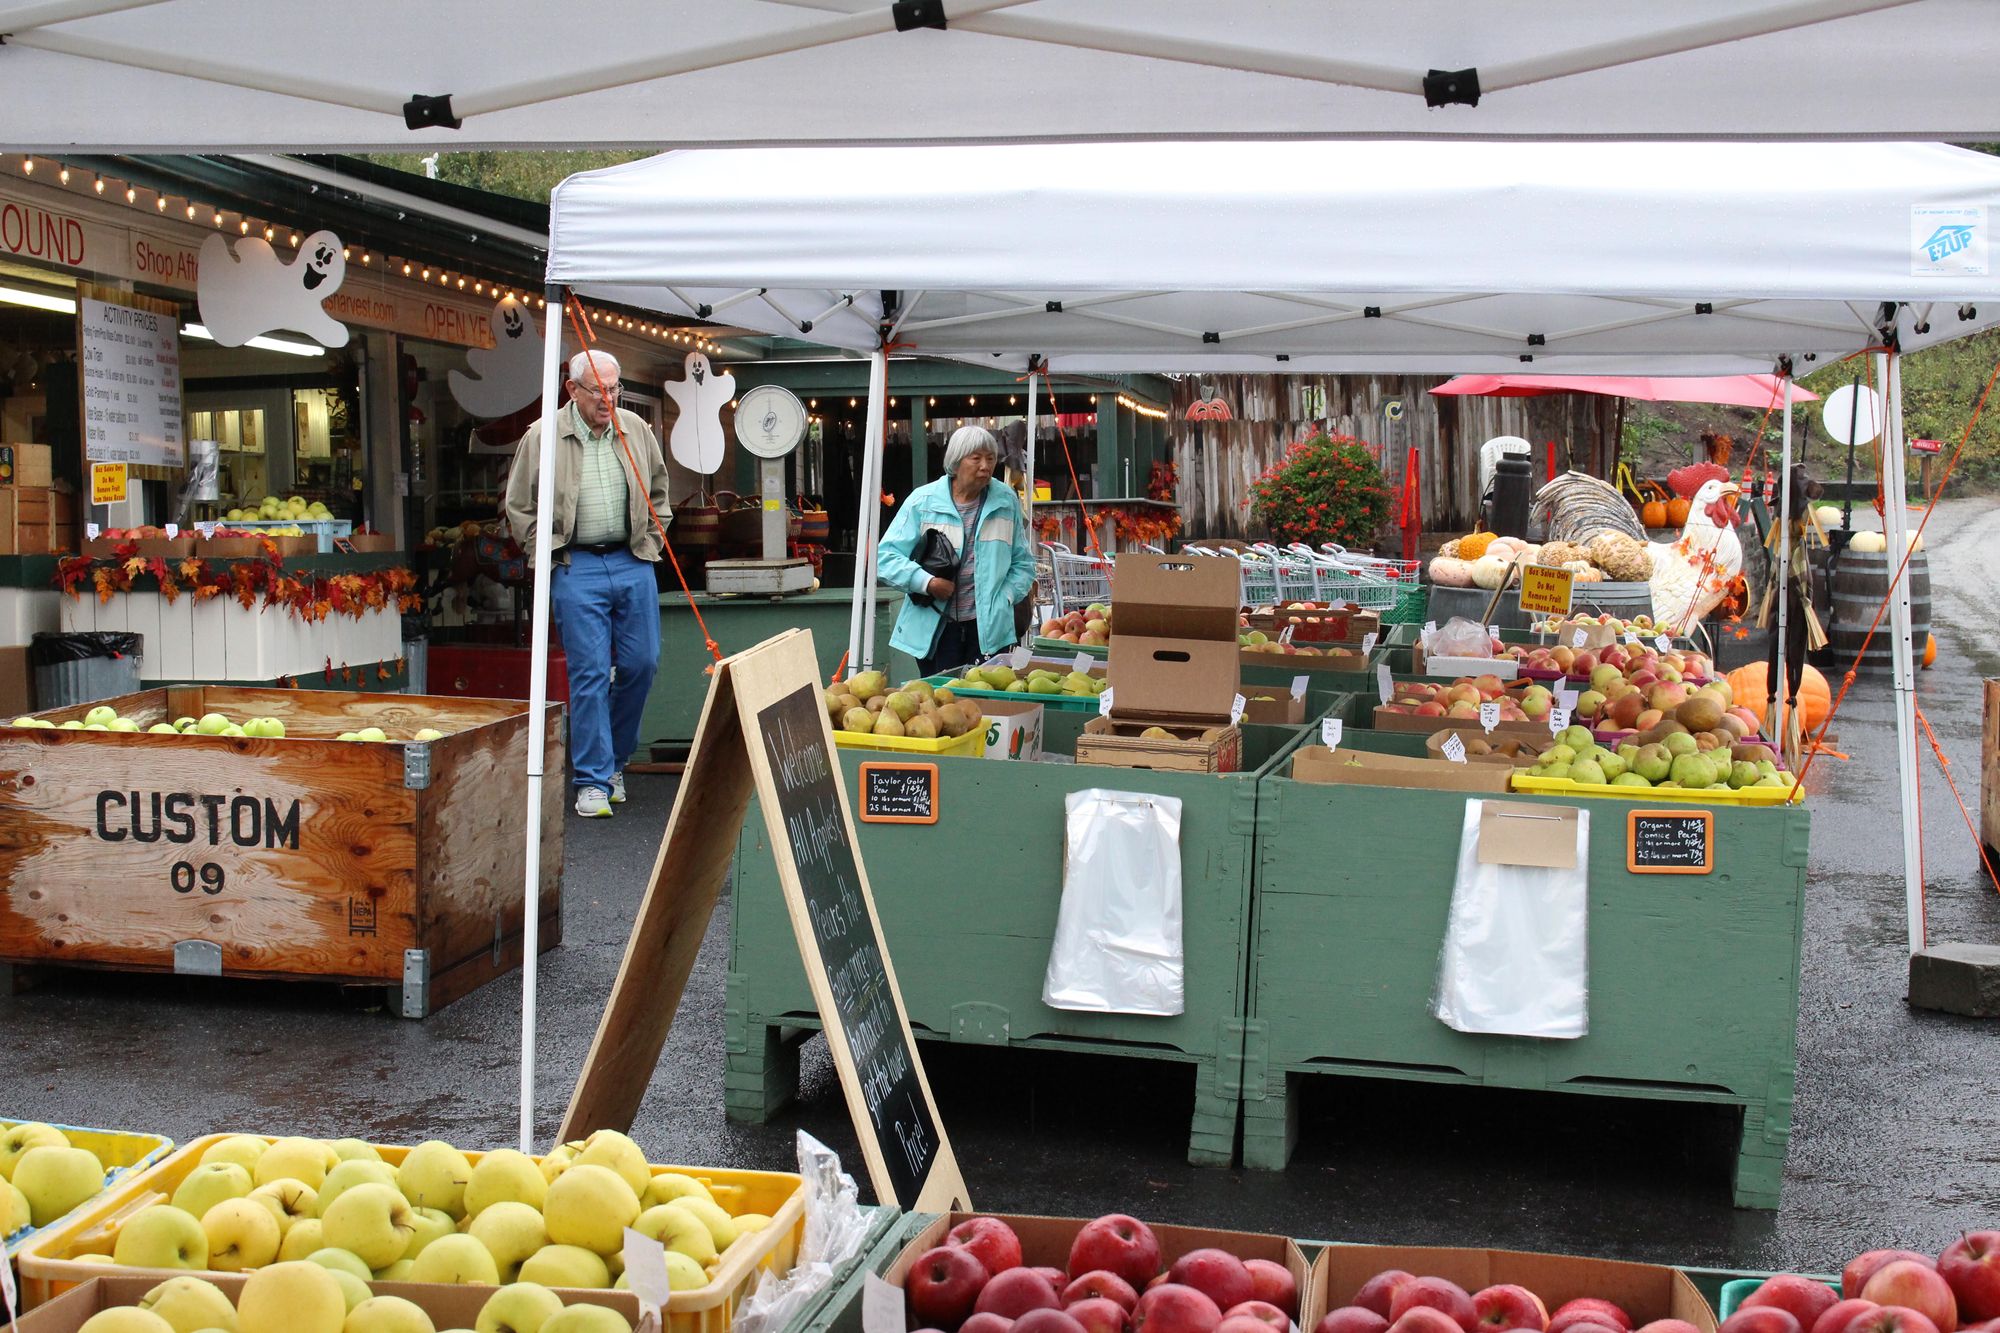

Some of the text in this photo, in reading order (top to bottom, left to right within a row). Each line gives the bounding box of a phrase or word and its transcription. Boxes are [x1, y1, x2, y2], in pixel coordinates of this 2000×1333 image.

[0, 203, 85, 266] OUND
[136, 241, 174, 283] Shop
[103, 306, 159, 332] ACTIVITY PRICES
[424, 303, 466, 341] OPEN
[1528, 567, 1569, 581] Box Sales Only
[1536, 581, 1555, 592] Do Not
[1521, 600, 1568, 615] from these Boxes
[1527, 591, 1562, 603] Remove Fruit
[767, 717, 827, 793] Welcome
[870, 773, 925, 787] Taylor Gold
[873, 784, 889, 794] Pear
[96, 789, 301, 851] CUSTOM
[869, 803, 880, 812] 25
[790, 812, 813, 867] All
[806, 795, 838, 874] Apples
[1638, 830, 1698, 839] Comice Pears
[1639, 820, 1672, 831] Organic
[1637, 850, 1649, 859] 25
[170, 861, 225, 895] 09
[810, 874, 861, 944] Pears the
[875, 986, 891, 1026] to
[864, 1043, 908, 1130] get the lower
[894, 1092, 929, 1178] Price!
